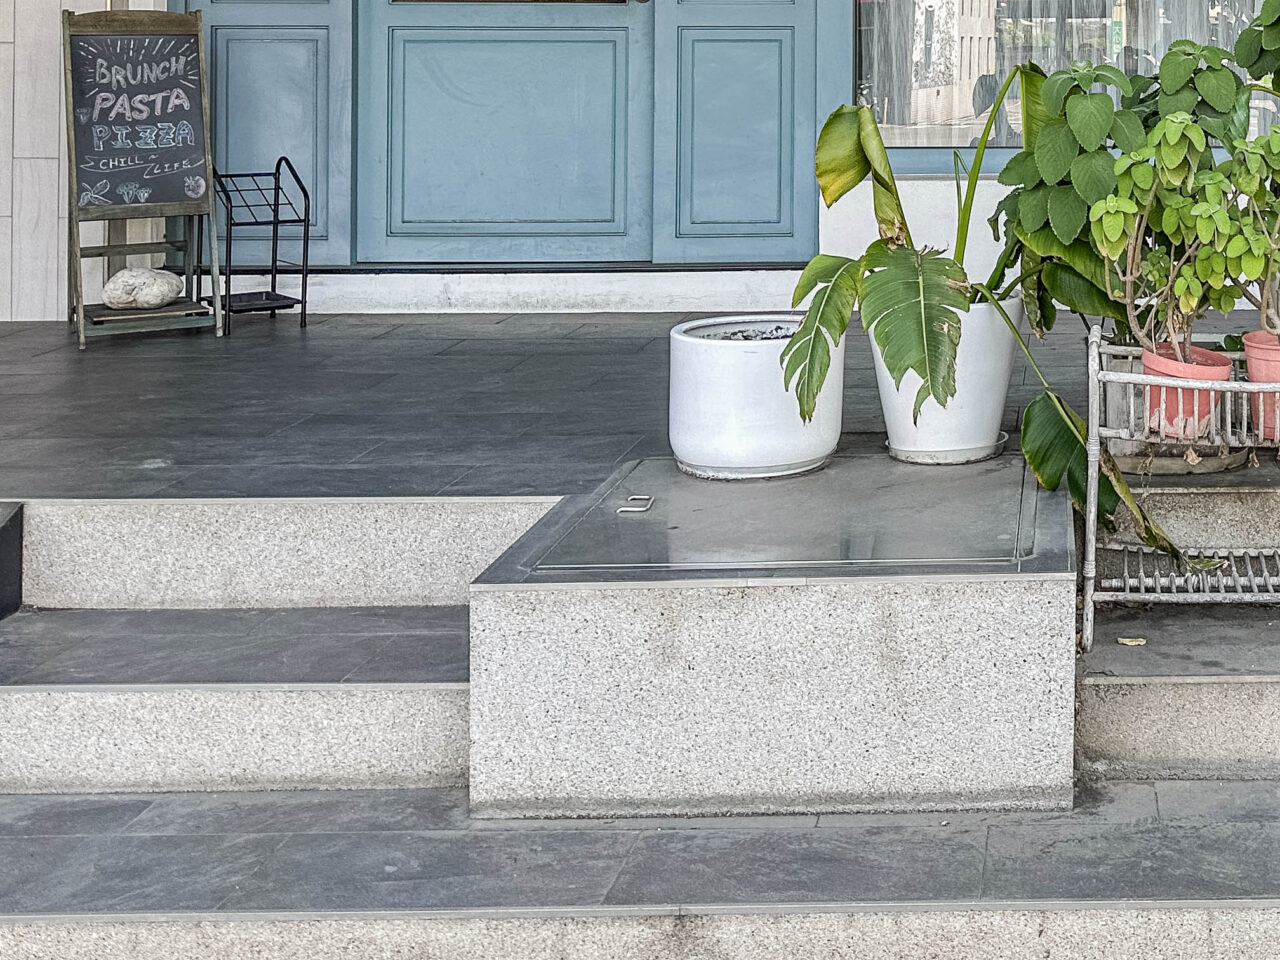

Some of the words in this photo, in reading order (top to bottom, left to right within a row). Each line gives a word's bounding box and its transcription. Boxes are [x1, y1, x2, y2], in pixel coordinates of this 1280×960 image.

[95, 55, 187, 90] BRUNCH
[92, 87, 191, 121] PASTA
[92, 120, 196, 151] PIZZA
[99, 155, 145, 170] CHILL
[153, 158, 191, 174] LIFE
